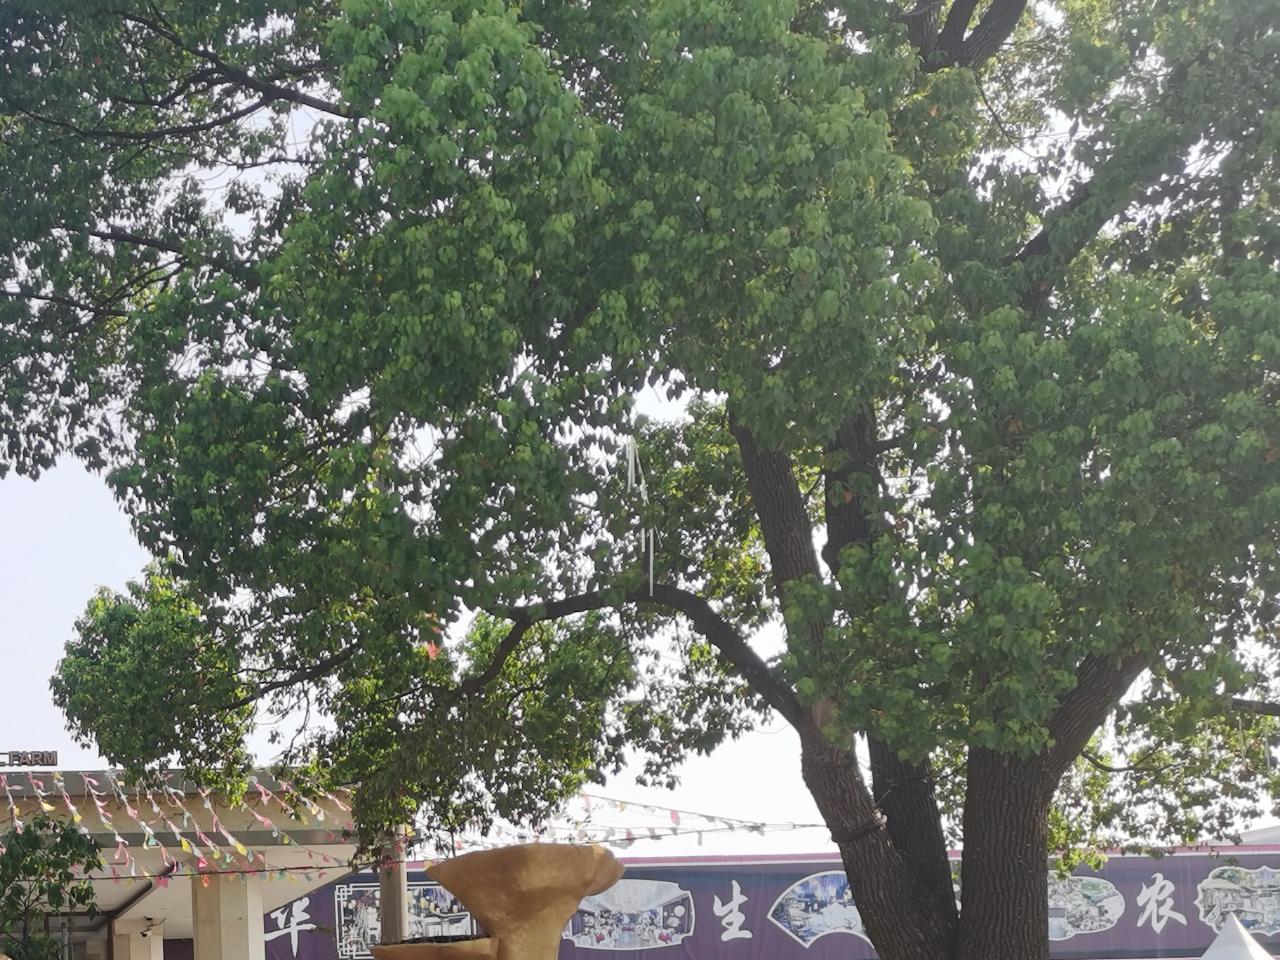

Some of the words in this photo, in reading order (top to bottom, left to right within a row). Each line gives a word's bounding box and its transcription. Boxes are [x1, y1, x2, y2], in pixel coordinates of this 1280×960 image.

[9, 751, 58, 767] FARM
[713, 879, 753, 942] 生
[1136, 872, 1188, 934] 农
